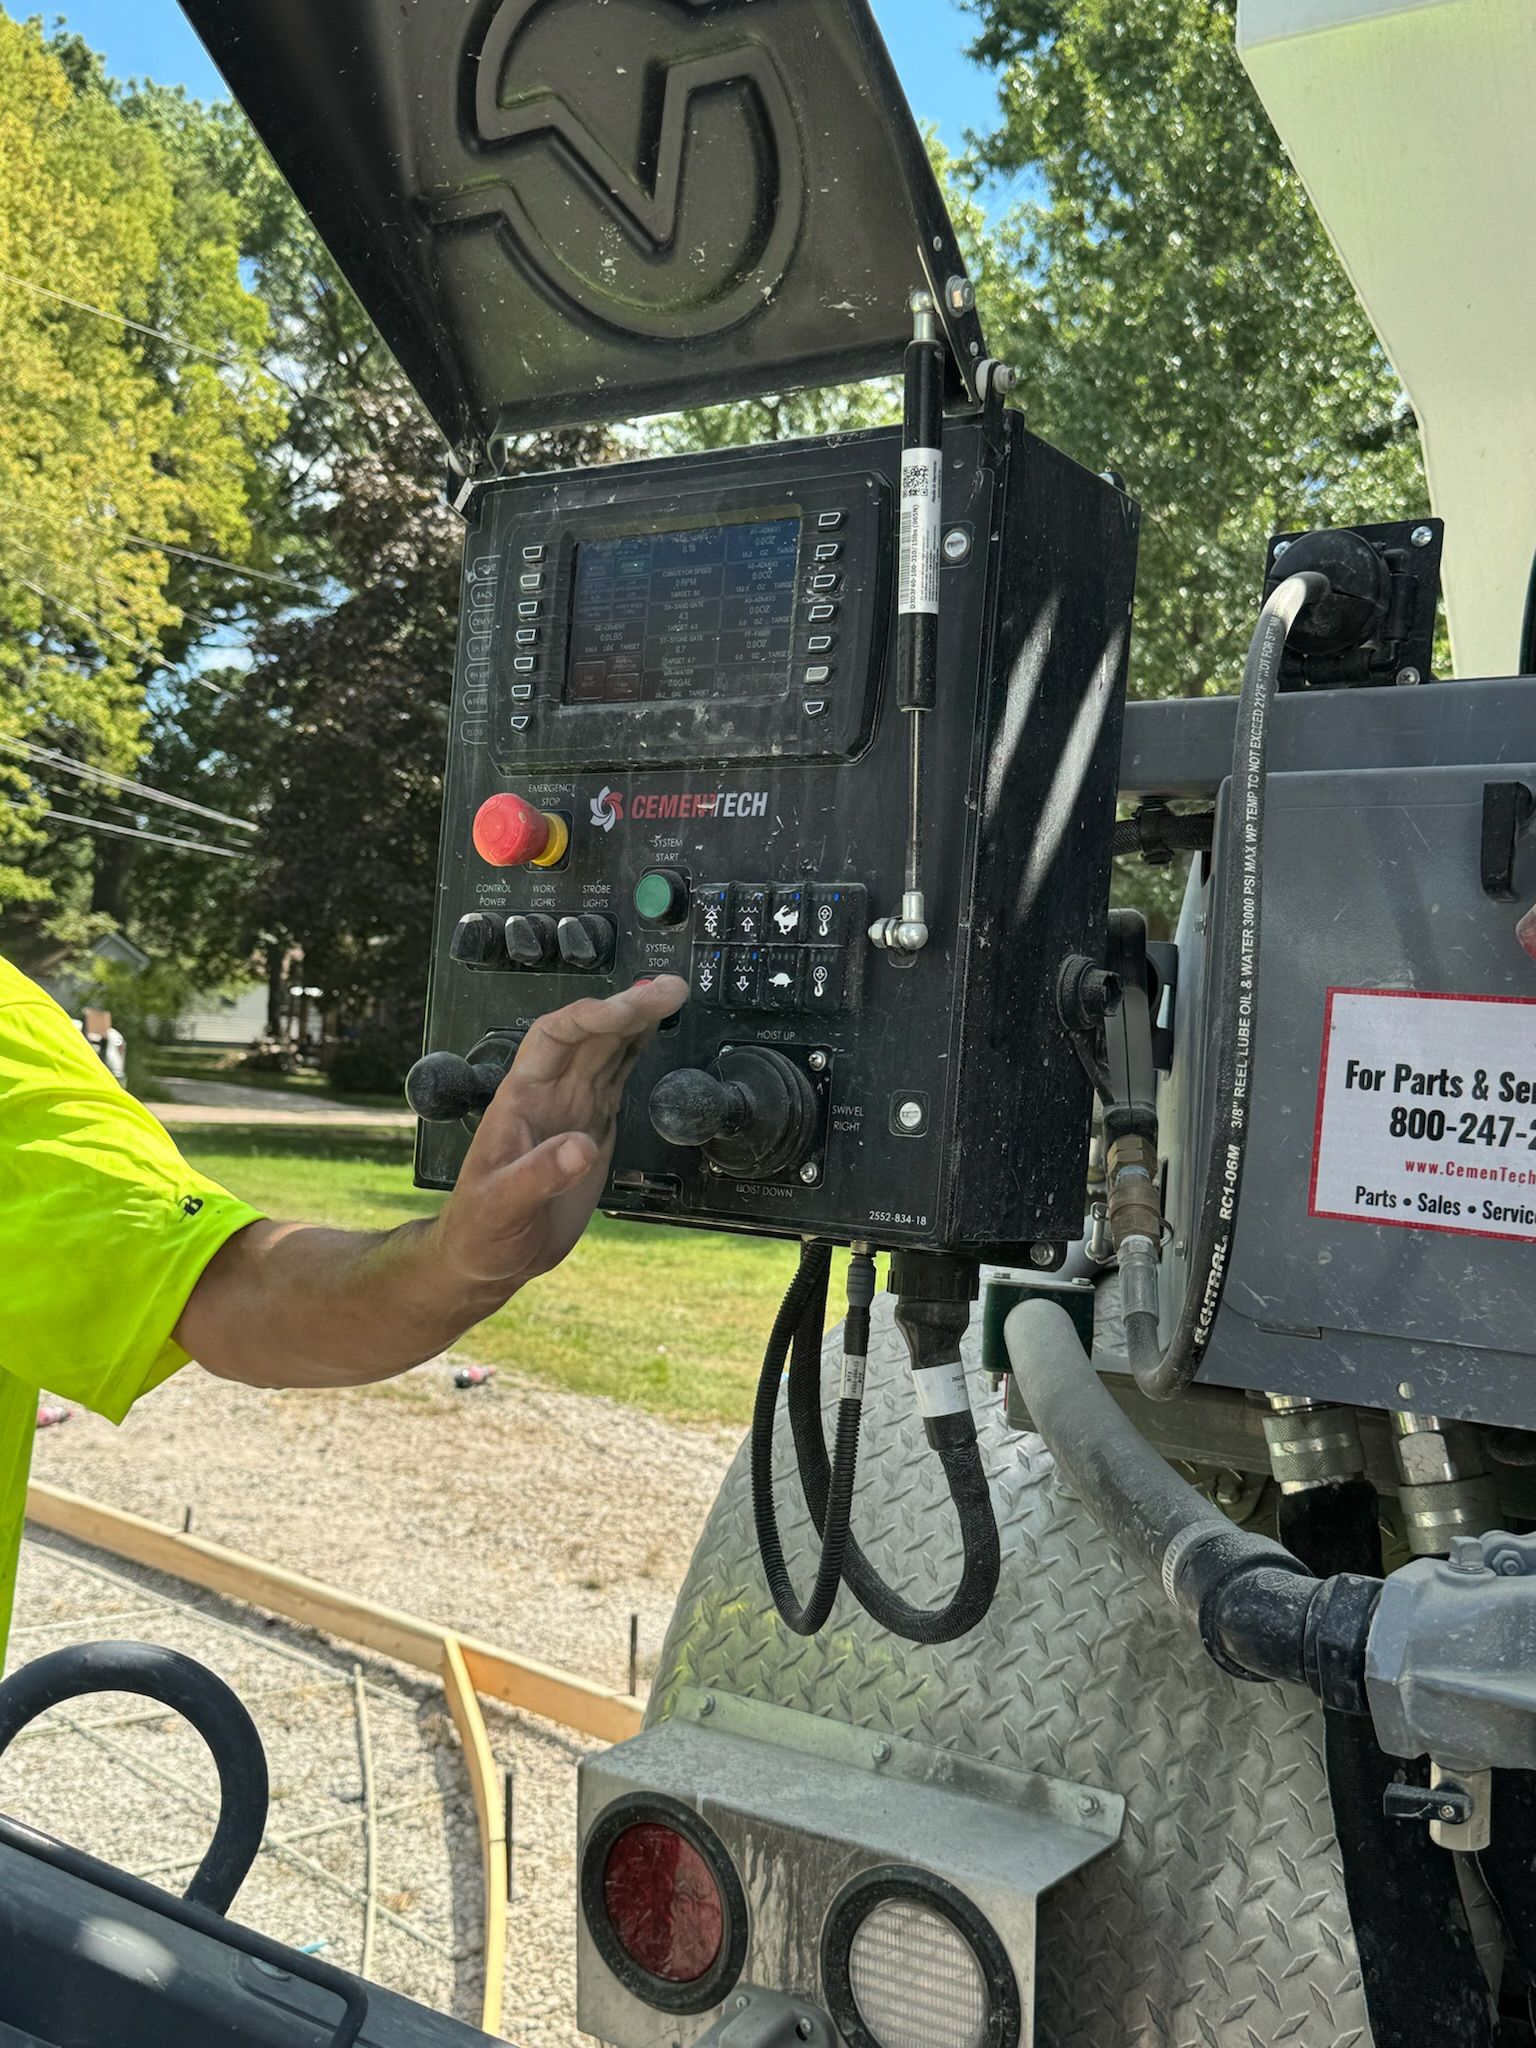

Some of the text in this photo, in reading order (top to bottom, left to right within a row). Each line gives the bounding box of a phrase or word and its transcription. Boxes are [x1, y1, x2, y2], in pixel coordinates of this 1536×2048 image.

[1262, 642, 1275, 658] FOR
[1250, 709, 1264, 749] EXCEED
[1249, 751, 1261, 773] NOT
[527, 783, 577, 793] EMERGENCY
[541, 797, 561, 807] STOP
[1247, 791, 1258, 821] TEMP
[1246, 823, 1257, 843] WP
[653, 838, 683, 848] SYSTEM
[655, 852, 679, 862] START
[1245, 846, 1257, 873] MAX
[475, 883, 511, 893] CONTROL
[532, 884, 556, 894] WORK
[582, 884, 612, 894] STROBE
[1244, 875, 1256, 895] PSI
[479, 897, 507, 907] POWER
[582, 898, 609, 908] LIGHTS
[1243, 899, 1255, 927] 3000
[645, 943, 675, 953] SYSTEM
[1241, 929, 1254, 976] WATER
[648, 957, 670, 968] STOP
[1241, 980, 1252, 990] &
[1239, 992, 1252, 1015] OIL
[756, 1030, 796, 1041] HOIST UP
[1238, 1018, 1251, 1056] LUBE
[1234, 1060, 1248, 1098] REEL
[1345, 1059, 1386, 1092] For
[1393, 1063, 1464, 1099] Parts
[1472, 1069, 1490, 1101] &
[831, 1104, 865, 1117] SWIVEL
[833, 1120, 861, 1132] RIGHT
[1219, 1143, 1240, 1221] RC1-06M
[735, 1183, 793, 1198] HOIST DOWN
[1355, 1185, 1536, 1225] Parts Sales Servic
[868, 1210, 927, 1226] 2552-834-18
